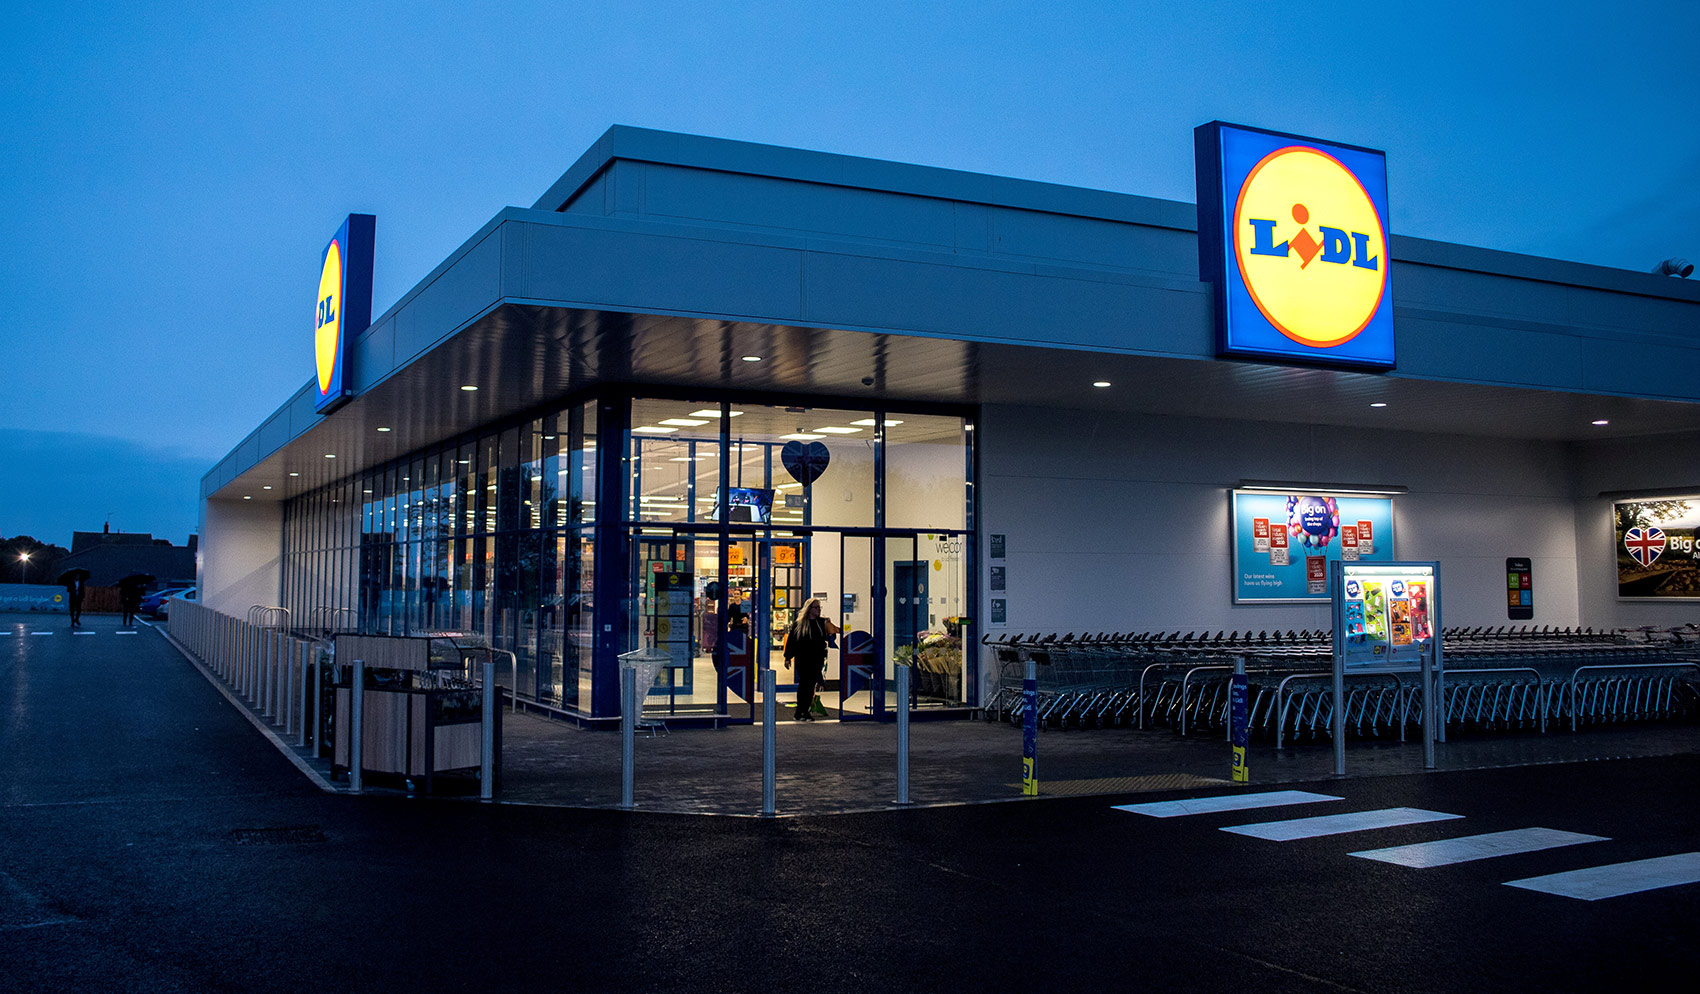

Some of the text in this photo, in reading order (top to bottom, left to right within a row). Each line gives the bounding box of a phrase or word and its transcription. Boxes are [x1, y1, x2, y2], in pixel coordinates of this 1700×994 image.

[1301, 504, 1326, 516] Big on
[1670, 536, 1692, 553] Big
